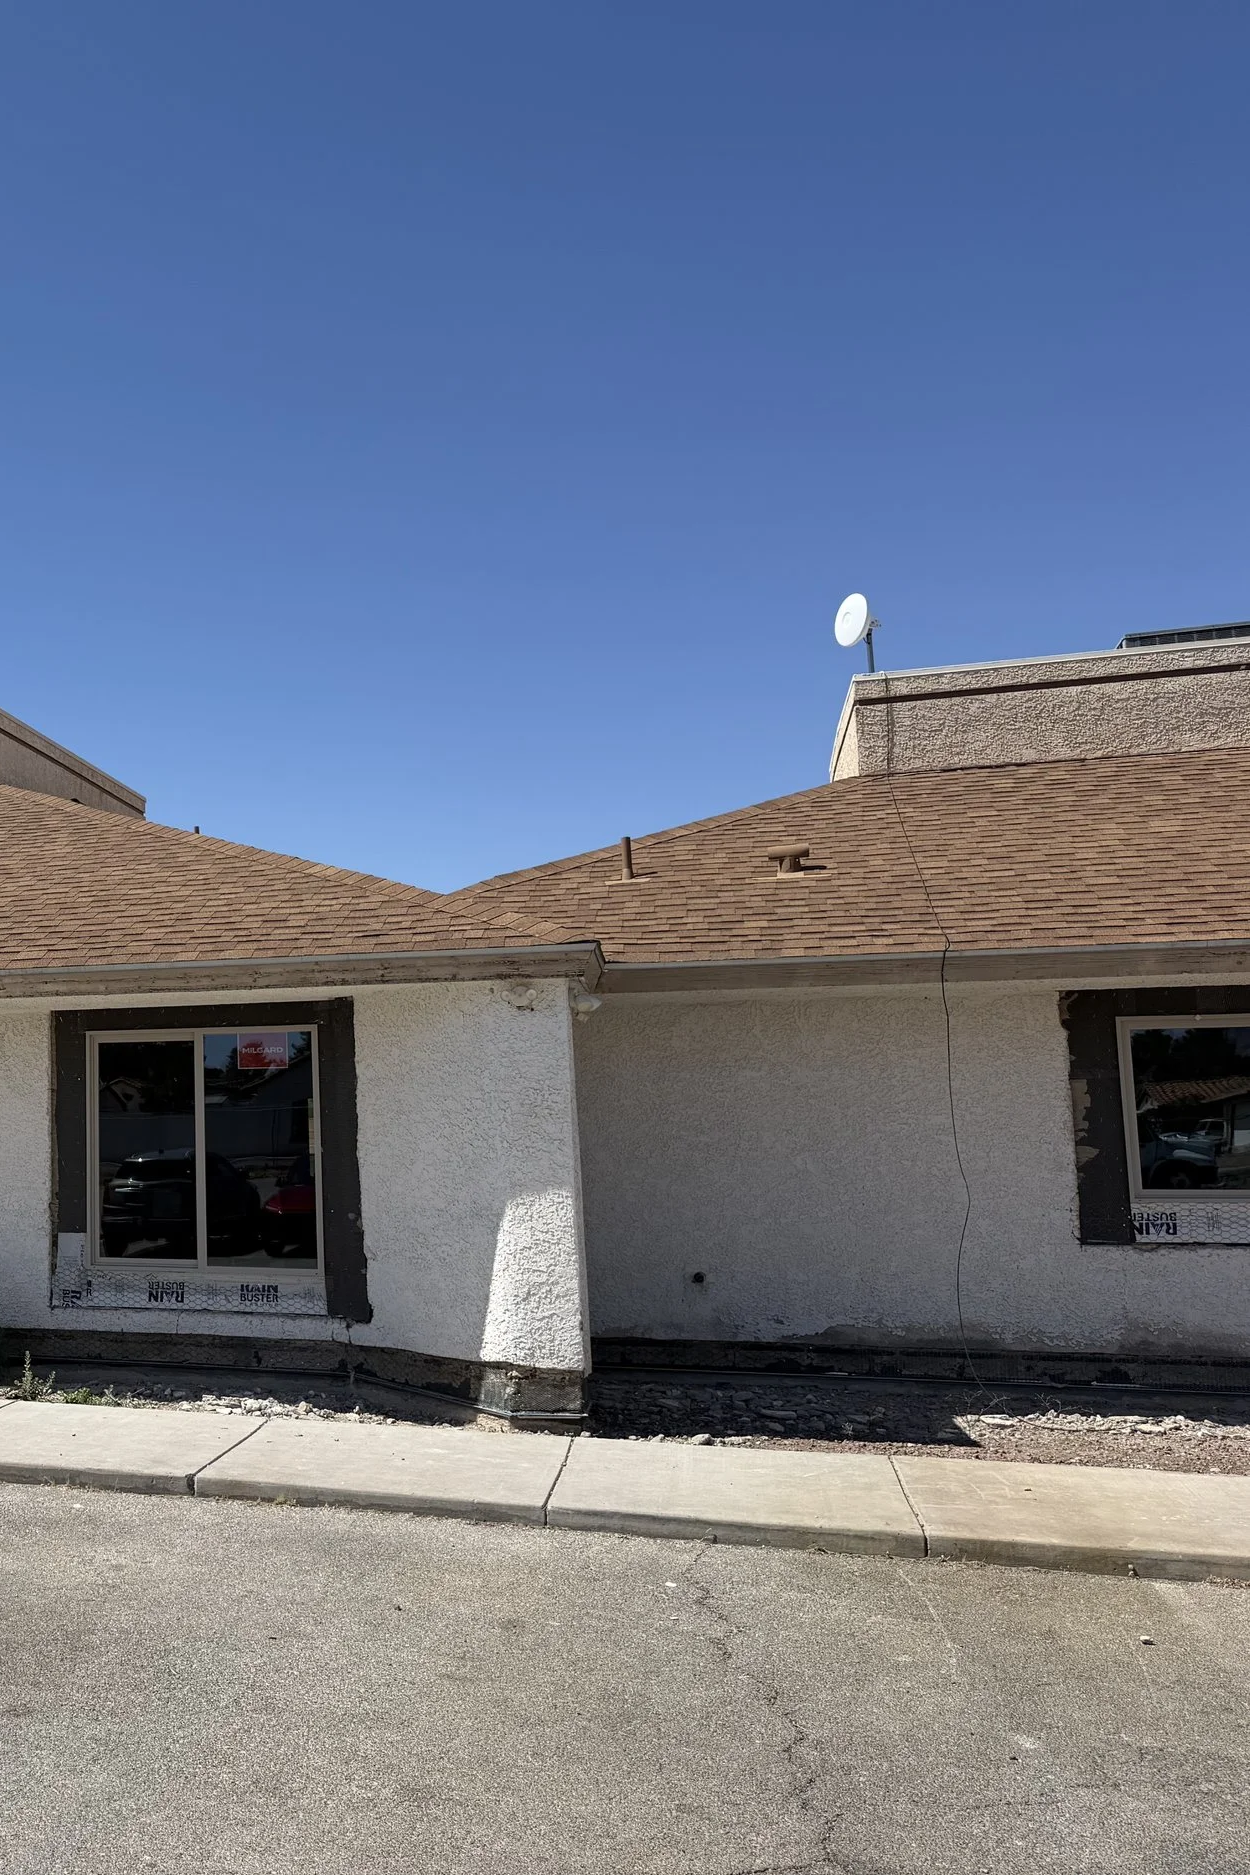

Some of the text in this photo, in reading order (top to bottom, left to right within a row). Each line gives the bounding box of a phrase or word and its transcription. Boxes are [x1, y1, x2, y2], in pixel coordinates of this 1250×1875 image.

[149, 1282, 185, 1290] BUSTER
[148, 1290, 185, 1303] RAIN
[240, 1293, 279, 1302] BUSTER
